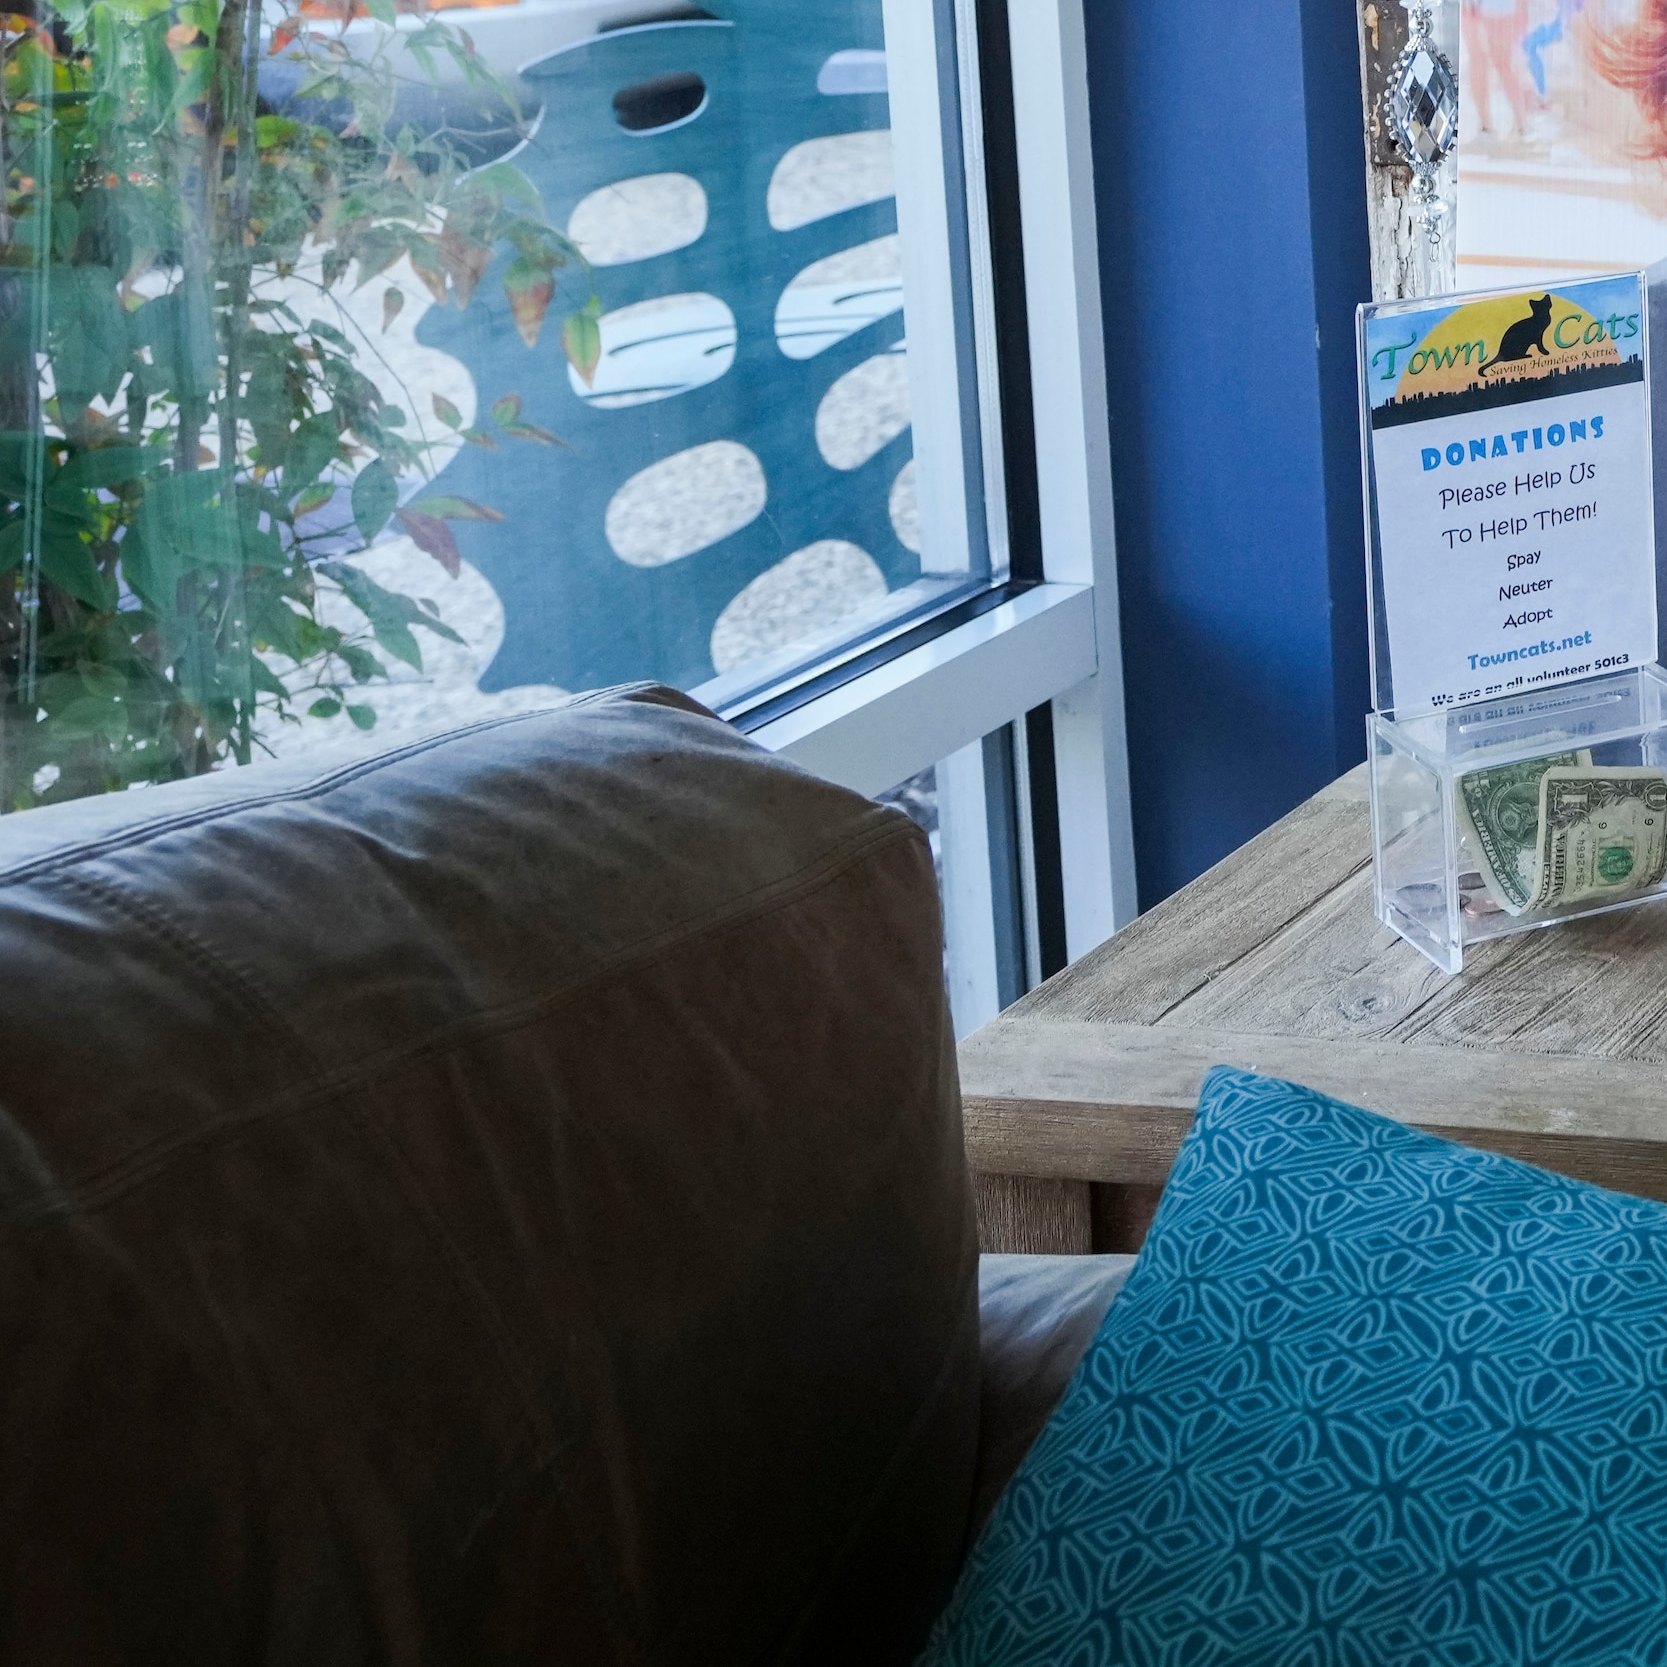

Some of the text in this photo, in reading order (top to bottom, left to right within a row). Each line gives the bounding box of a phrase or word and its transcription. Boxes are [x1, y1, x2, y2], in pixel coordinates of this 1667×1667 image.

[1372, 311, 1640, 381] Town Cats
[1489, 347, 1619, 377] Saving Homeless Kitties
[1421, 415, 1604, 471] DONATIONS
[1438, 462, 1596, 510] Please Help Us
[1441, 501, 1598, 549] To Help Them!
[1507, 550, 1541, 572] Spay
[1499, 578, 1553, 602] Neuter
[1502, 607, 1553, 630] Adopt
[1467, 630, 1592, 671] Towncats.net
[1506, 676, 1524, 690] all
[1527, 663, 1591, 684] volunteer
[1594, 653, 1630, 670] 501c3
